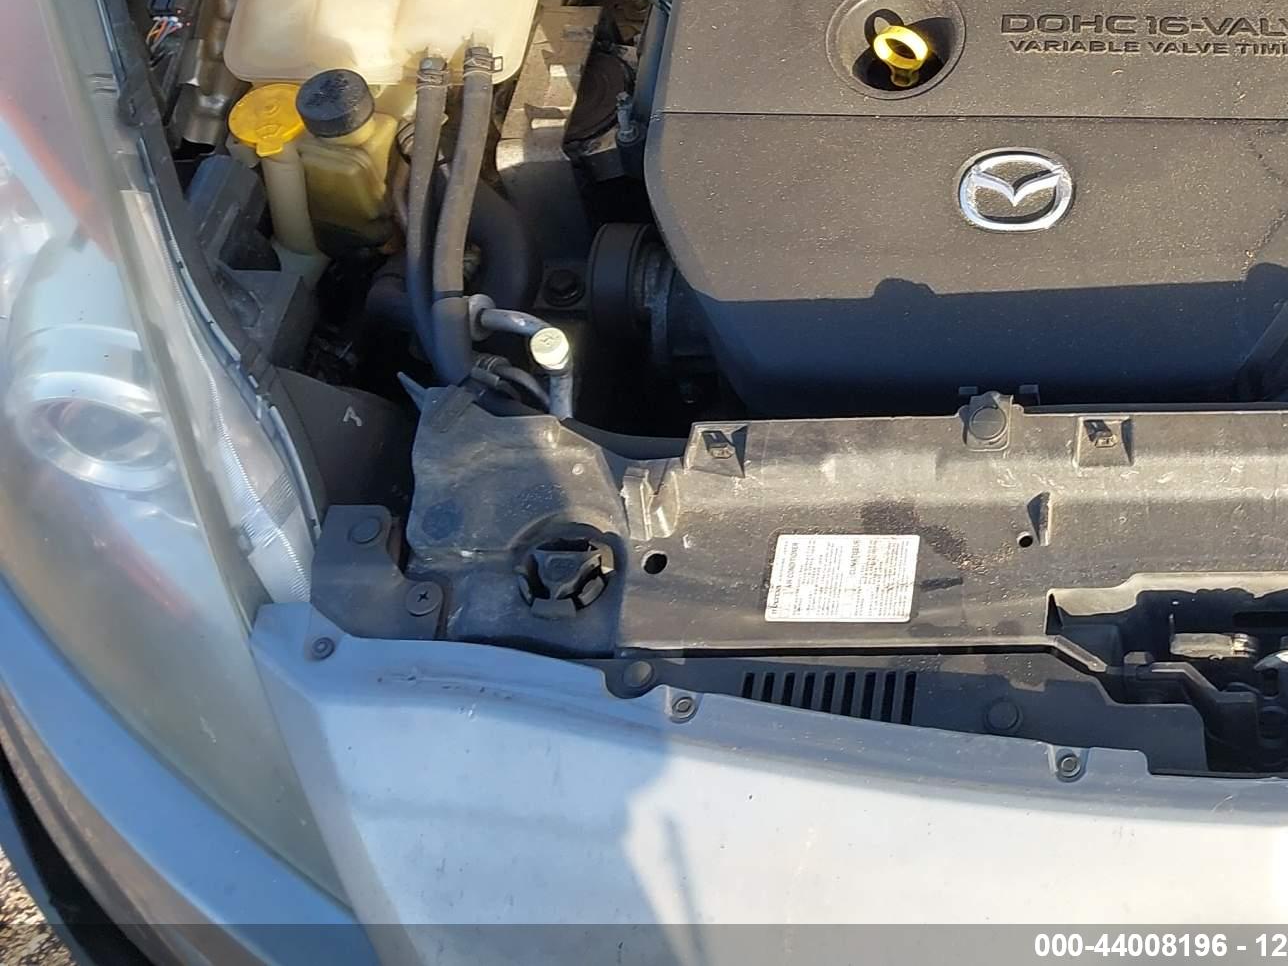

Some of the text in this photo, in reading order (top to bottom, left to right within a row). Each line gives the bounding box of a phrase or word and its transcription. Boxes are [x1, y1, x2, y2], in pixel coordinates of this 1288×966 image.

[1000, 13, 1138, 35] DOHC
[1009, 40, 1141, 54] VARIABLE
[1147, 41, 1230, 56] VALVE
